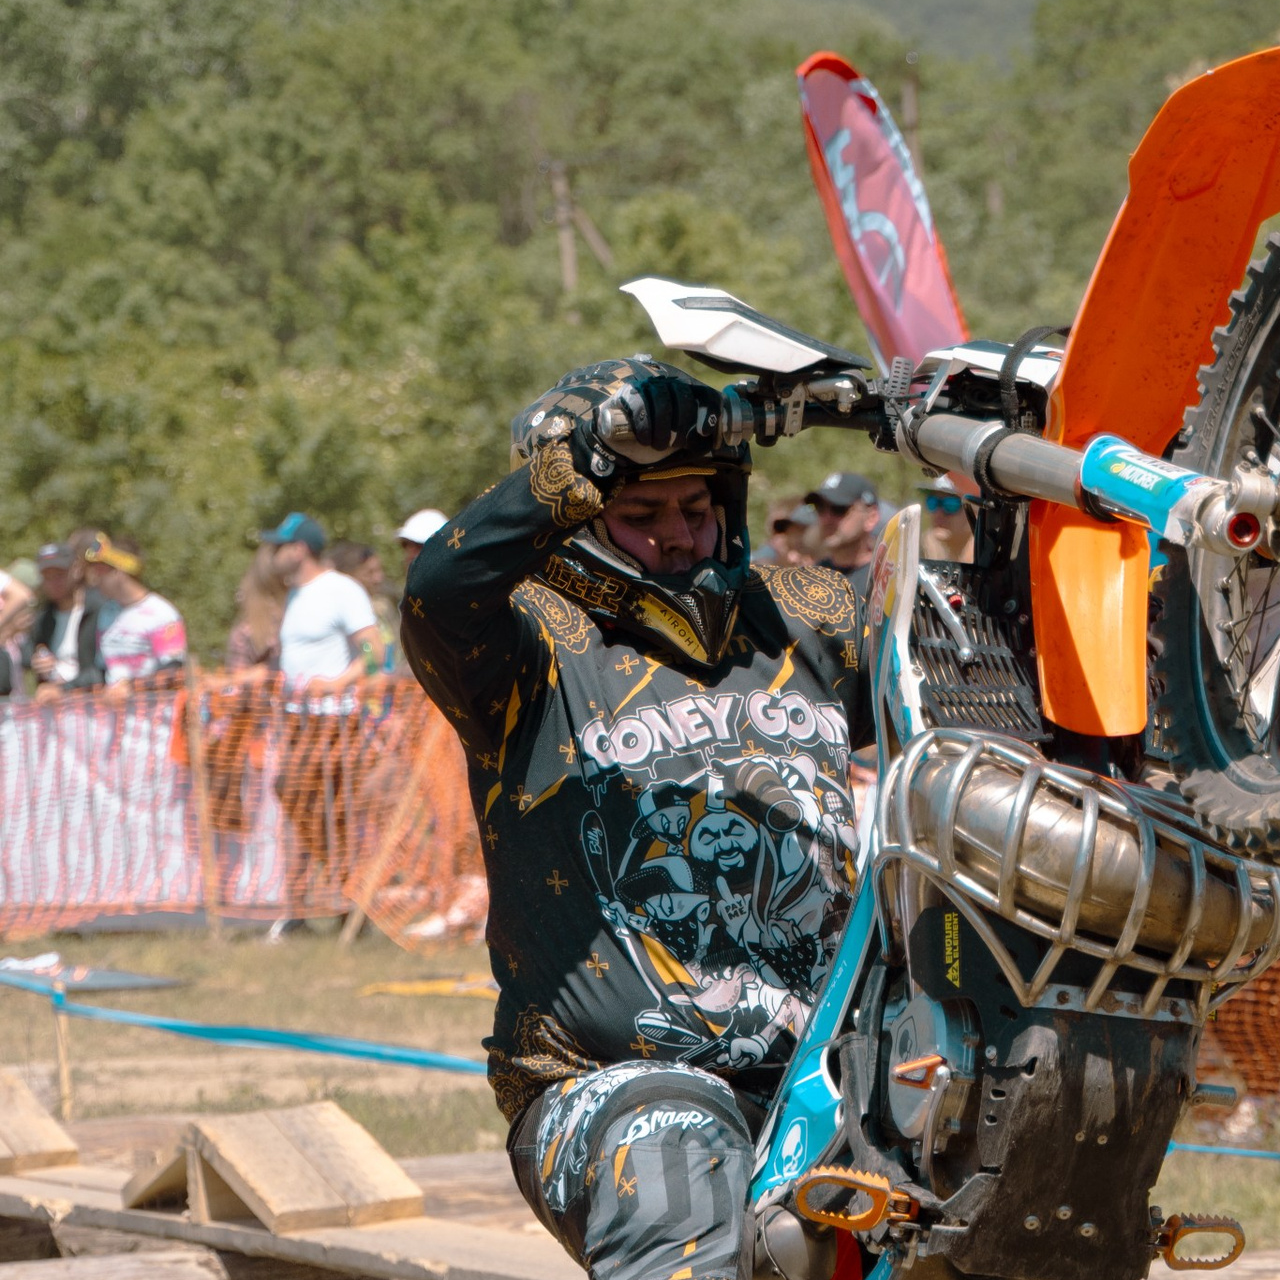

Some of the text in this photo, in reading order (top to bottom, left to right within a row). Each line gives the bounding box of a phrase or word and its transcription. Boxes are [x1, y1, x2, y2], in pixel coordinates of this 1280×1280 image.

[1118, 464, 1163, 491] MOTOREX
[659, 608, 695, 647] AIROH
[582, 695, 735, 775] OONEY
[587, 826, 604, 856] Billy
[724, 900, 744, 915] PAY
[727, 907, 747, 921] ME
[944, 912, 953, 964] ENDURO
